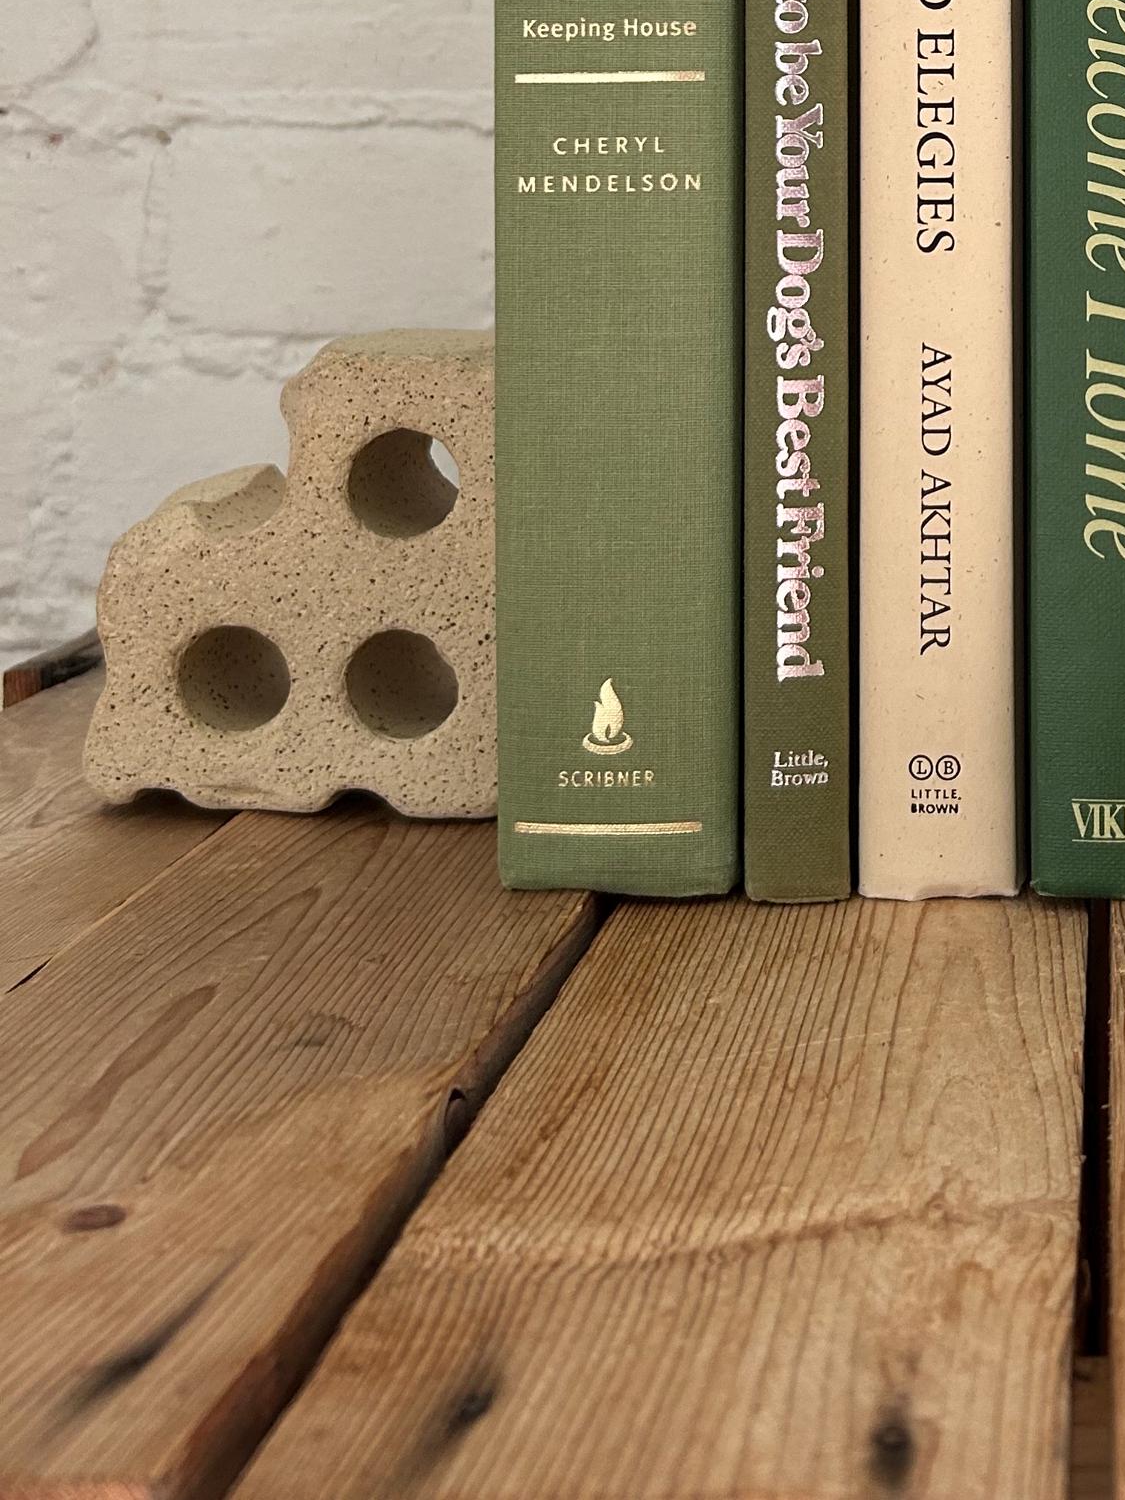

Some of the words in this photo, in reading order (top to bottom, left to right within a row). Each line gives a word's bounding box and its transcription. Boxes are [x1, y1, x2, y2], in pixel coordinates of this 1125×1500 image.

[522, 18, 615, 41] Keeping
[623, 17, 697, 37] House
[774, 38, 823, 106] be
[552, 136, 666, 156] CHERYL
[775, 103, 824, 227] Your
[916, 27, 957, 255] ELEGIES
[517, 173, 702, 194] MENDELSON
[766, 228, 825, 370] Dog's
[921, 341, 953, 458] AYAD
[775, 374, 825, 500] Best
[776, 502, 826, 684] Friend
[919, 468, 953, 657] AKHTAR
[558, 769, 655, 788] SCRIBNER
[770, 769, 830, 788] Brown
[772, 750, 830, 770] Little,
[911, 802, 959, 815] BROWN
